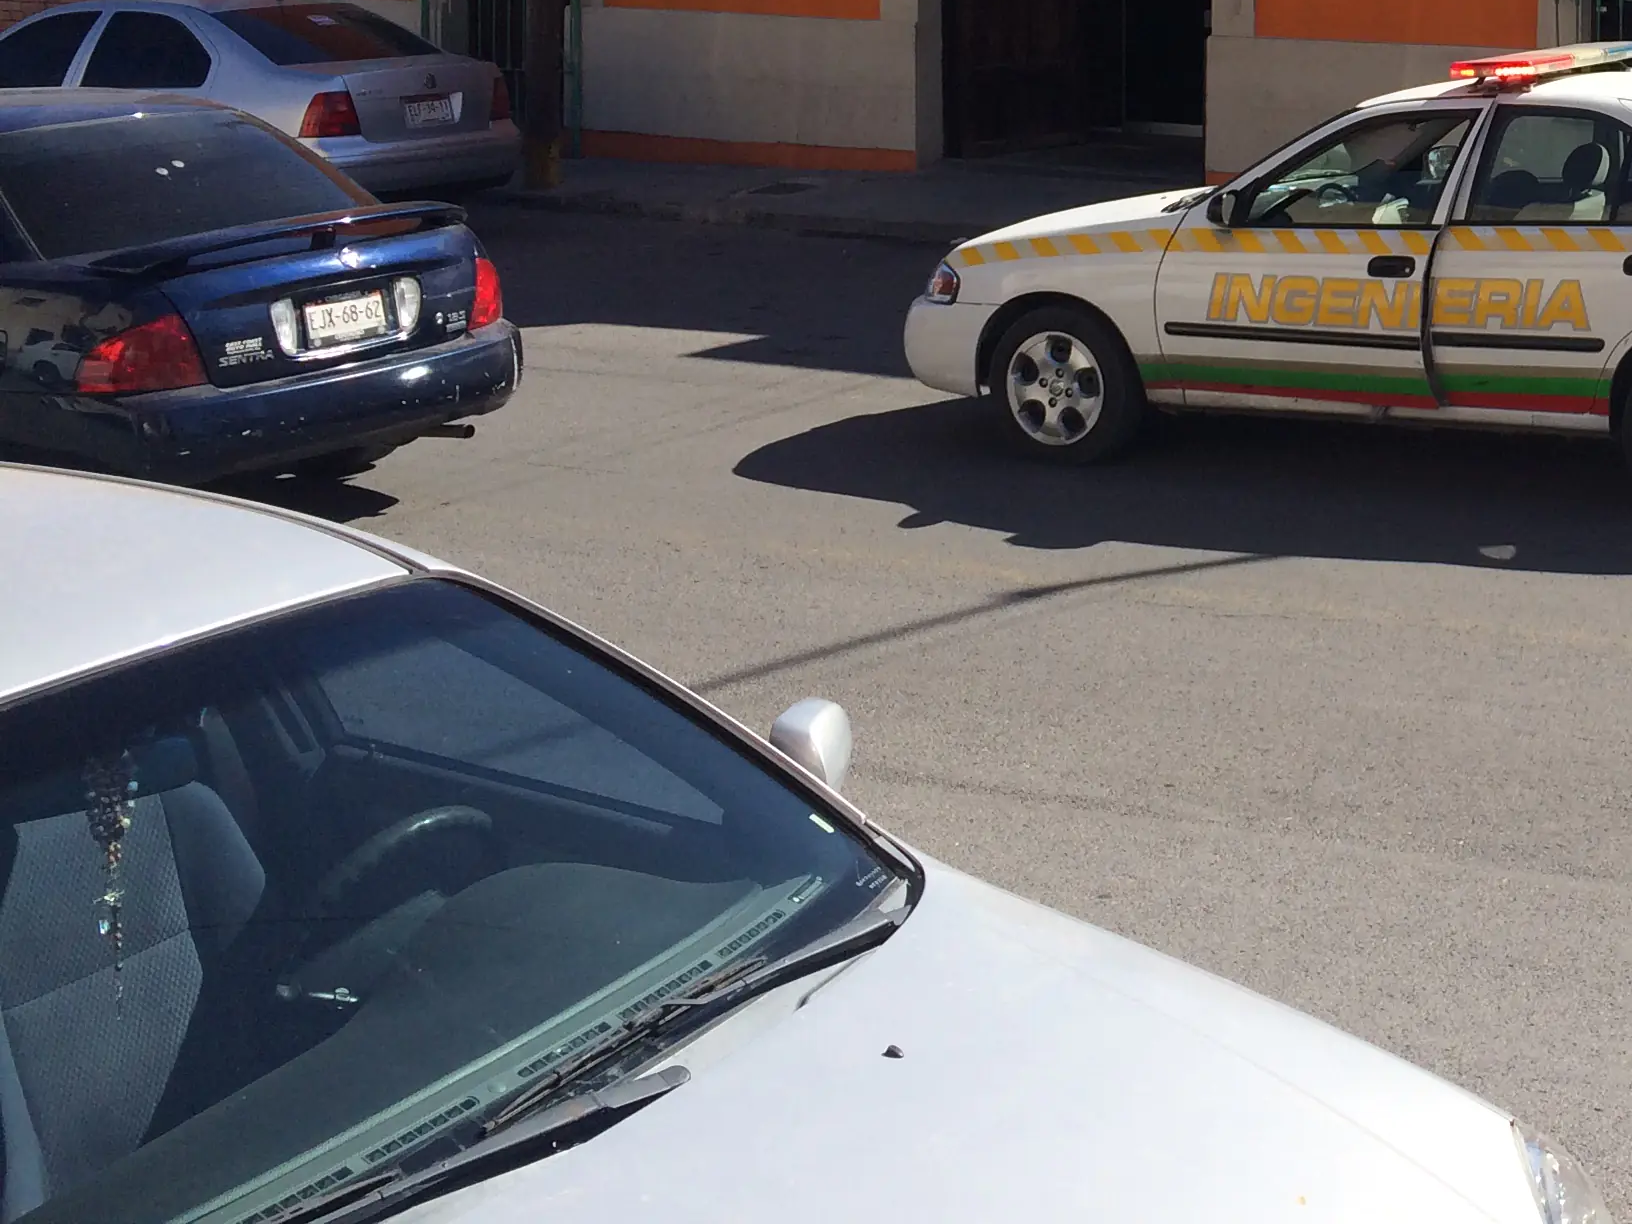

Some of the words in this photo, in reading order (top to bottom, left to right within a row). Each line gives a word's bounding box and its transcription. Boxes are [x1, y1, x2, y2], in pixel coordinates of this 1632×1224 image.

[308, 300, 382, 331] EJX-68-62
[1205, 272, 1592, 332] INGENIERIA
[218, 349, 275, 367] SENTRA
